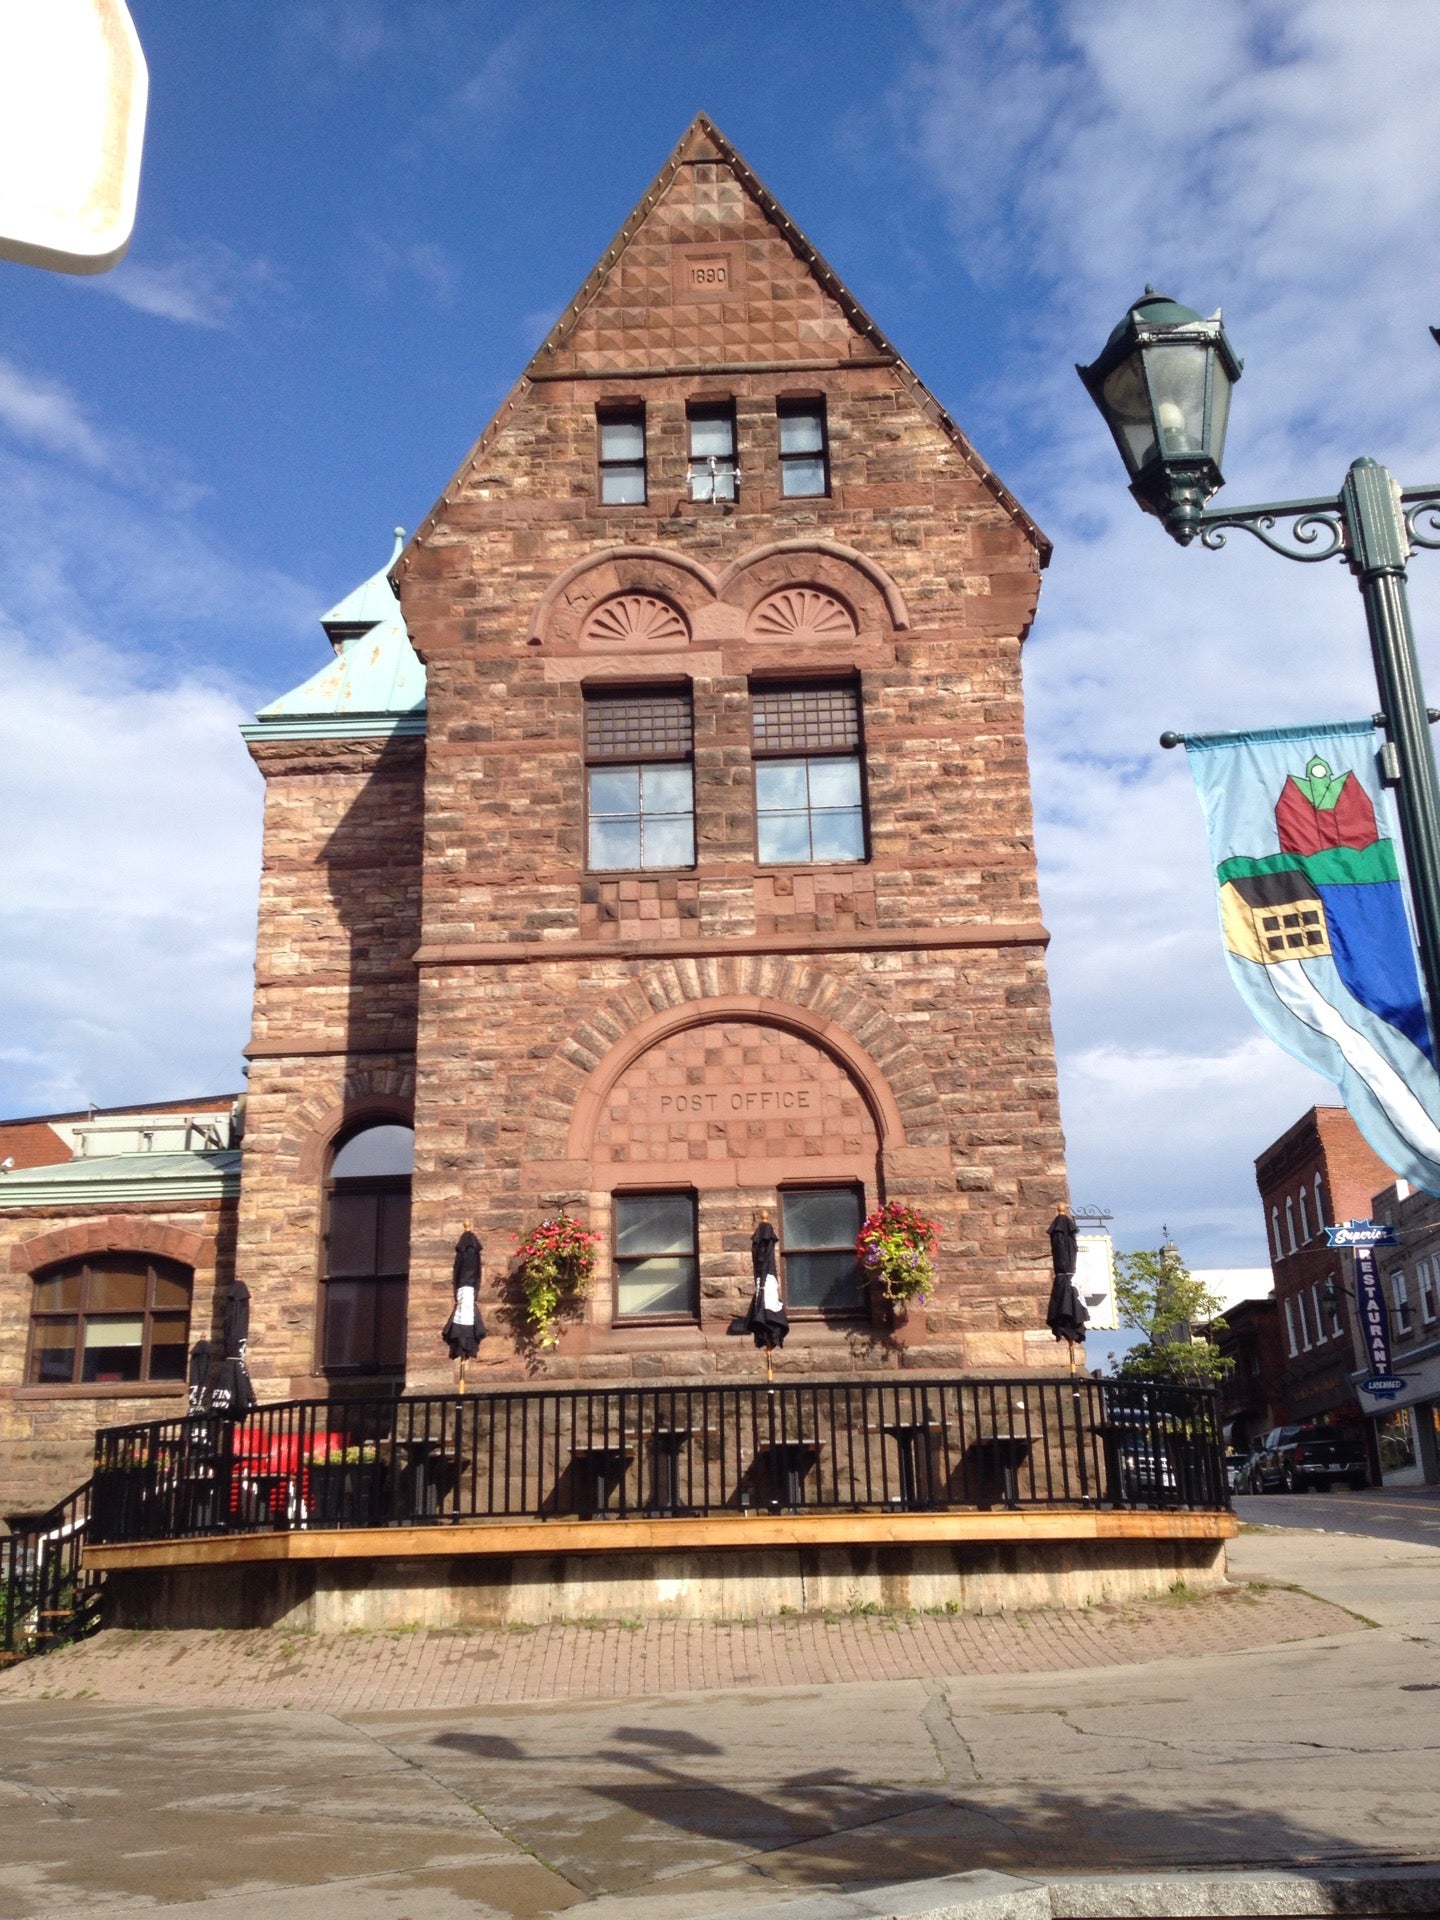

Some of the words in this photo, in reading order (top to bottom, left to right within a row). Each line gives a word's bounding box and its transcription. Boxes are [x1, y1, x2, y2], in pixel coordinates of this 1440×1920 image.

[691, 267, 726, 284] 1890
[660, 1094, 718, 1113] POST
[731, 1090, 810, 1110] OFFICE
[1334, 1228, 1388, 1244] Superior
[1358, 1249, 1388, 1375] RESTAURANT
[1368, 1380, 1402, 1390] LICENSED
